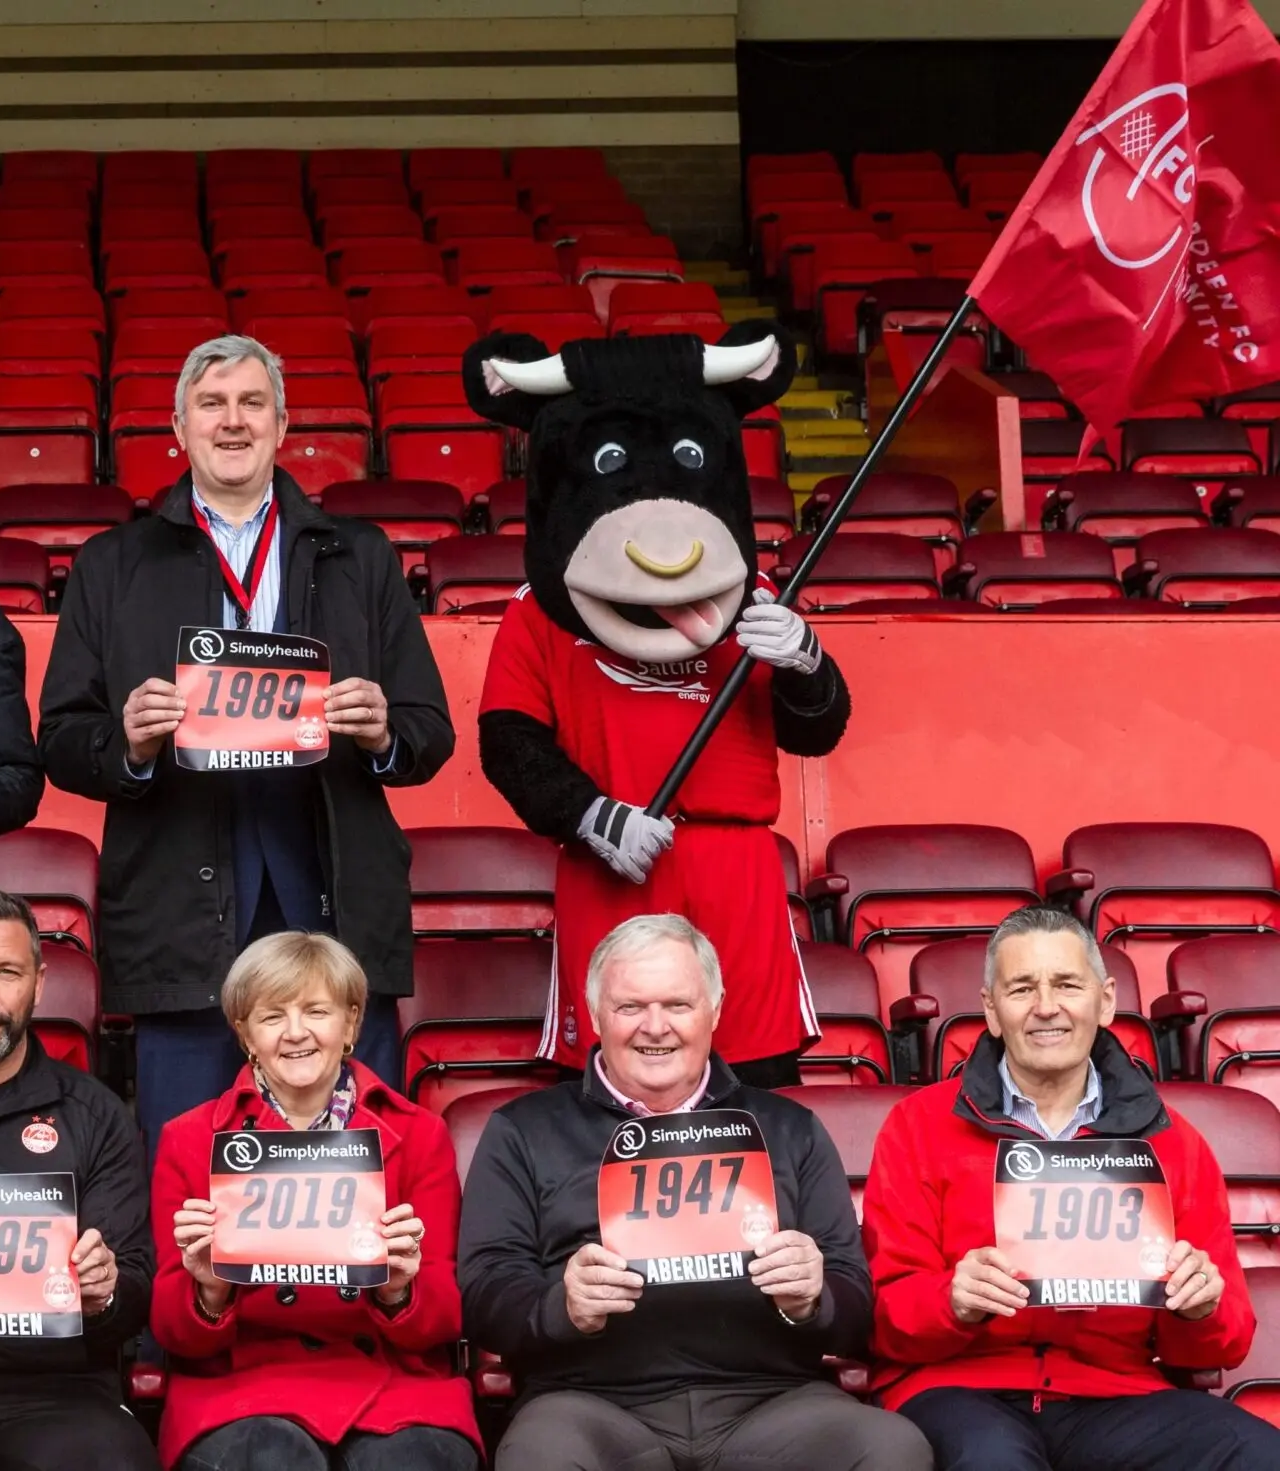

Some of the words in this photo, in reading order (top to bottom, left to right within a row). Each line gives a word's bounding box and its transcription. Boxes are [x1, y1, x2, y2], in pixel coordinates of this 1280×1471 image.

[229, 642, 319, 660] Simplyhealth
[198, 670, 306, 722] 1989
[678, 690, 710, 704] energy
[207, 750, 294, 769] ABERDEEN
[651, 1123, 752, 1143] Simplyhealth
[268, 1144, 369, 1161] Simplyhealth
[1050, 1154, 1154, 1171] Simplyhealth
[625, 1157, 745, 1221] 1947
[237, 1176, 358, 1230] 2019
[1023, 1187, 1144, 1242] 1903
[250, 1264, 349, 1285] ABERDEEN
[646, 1252, 744, 1284] ABERDEEN
[1040, 1278, 1141, 1305] ABERDEEN
